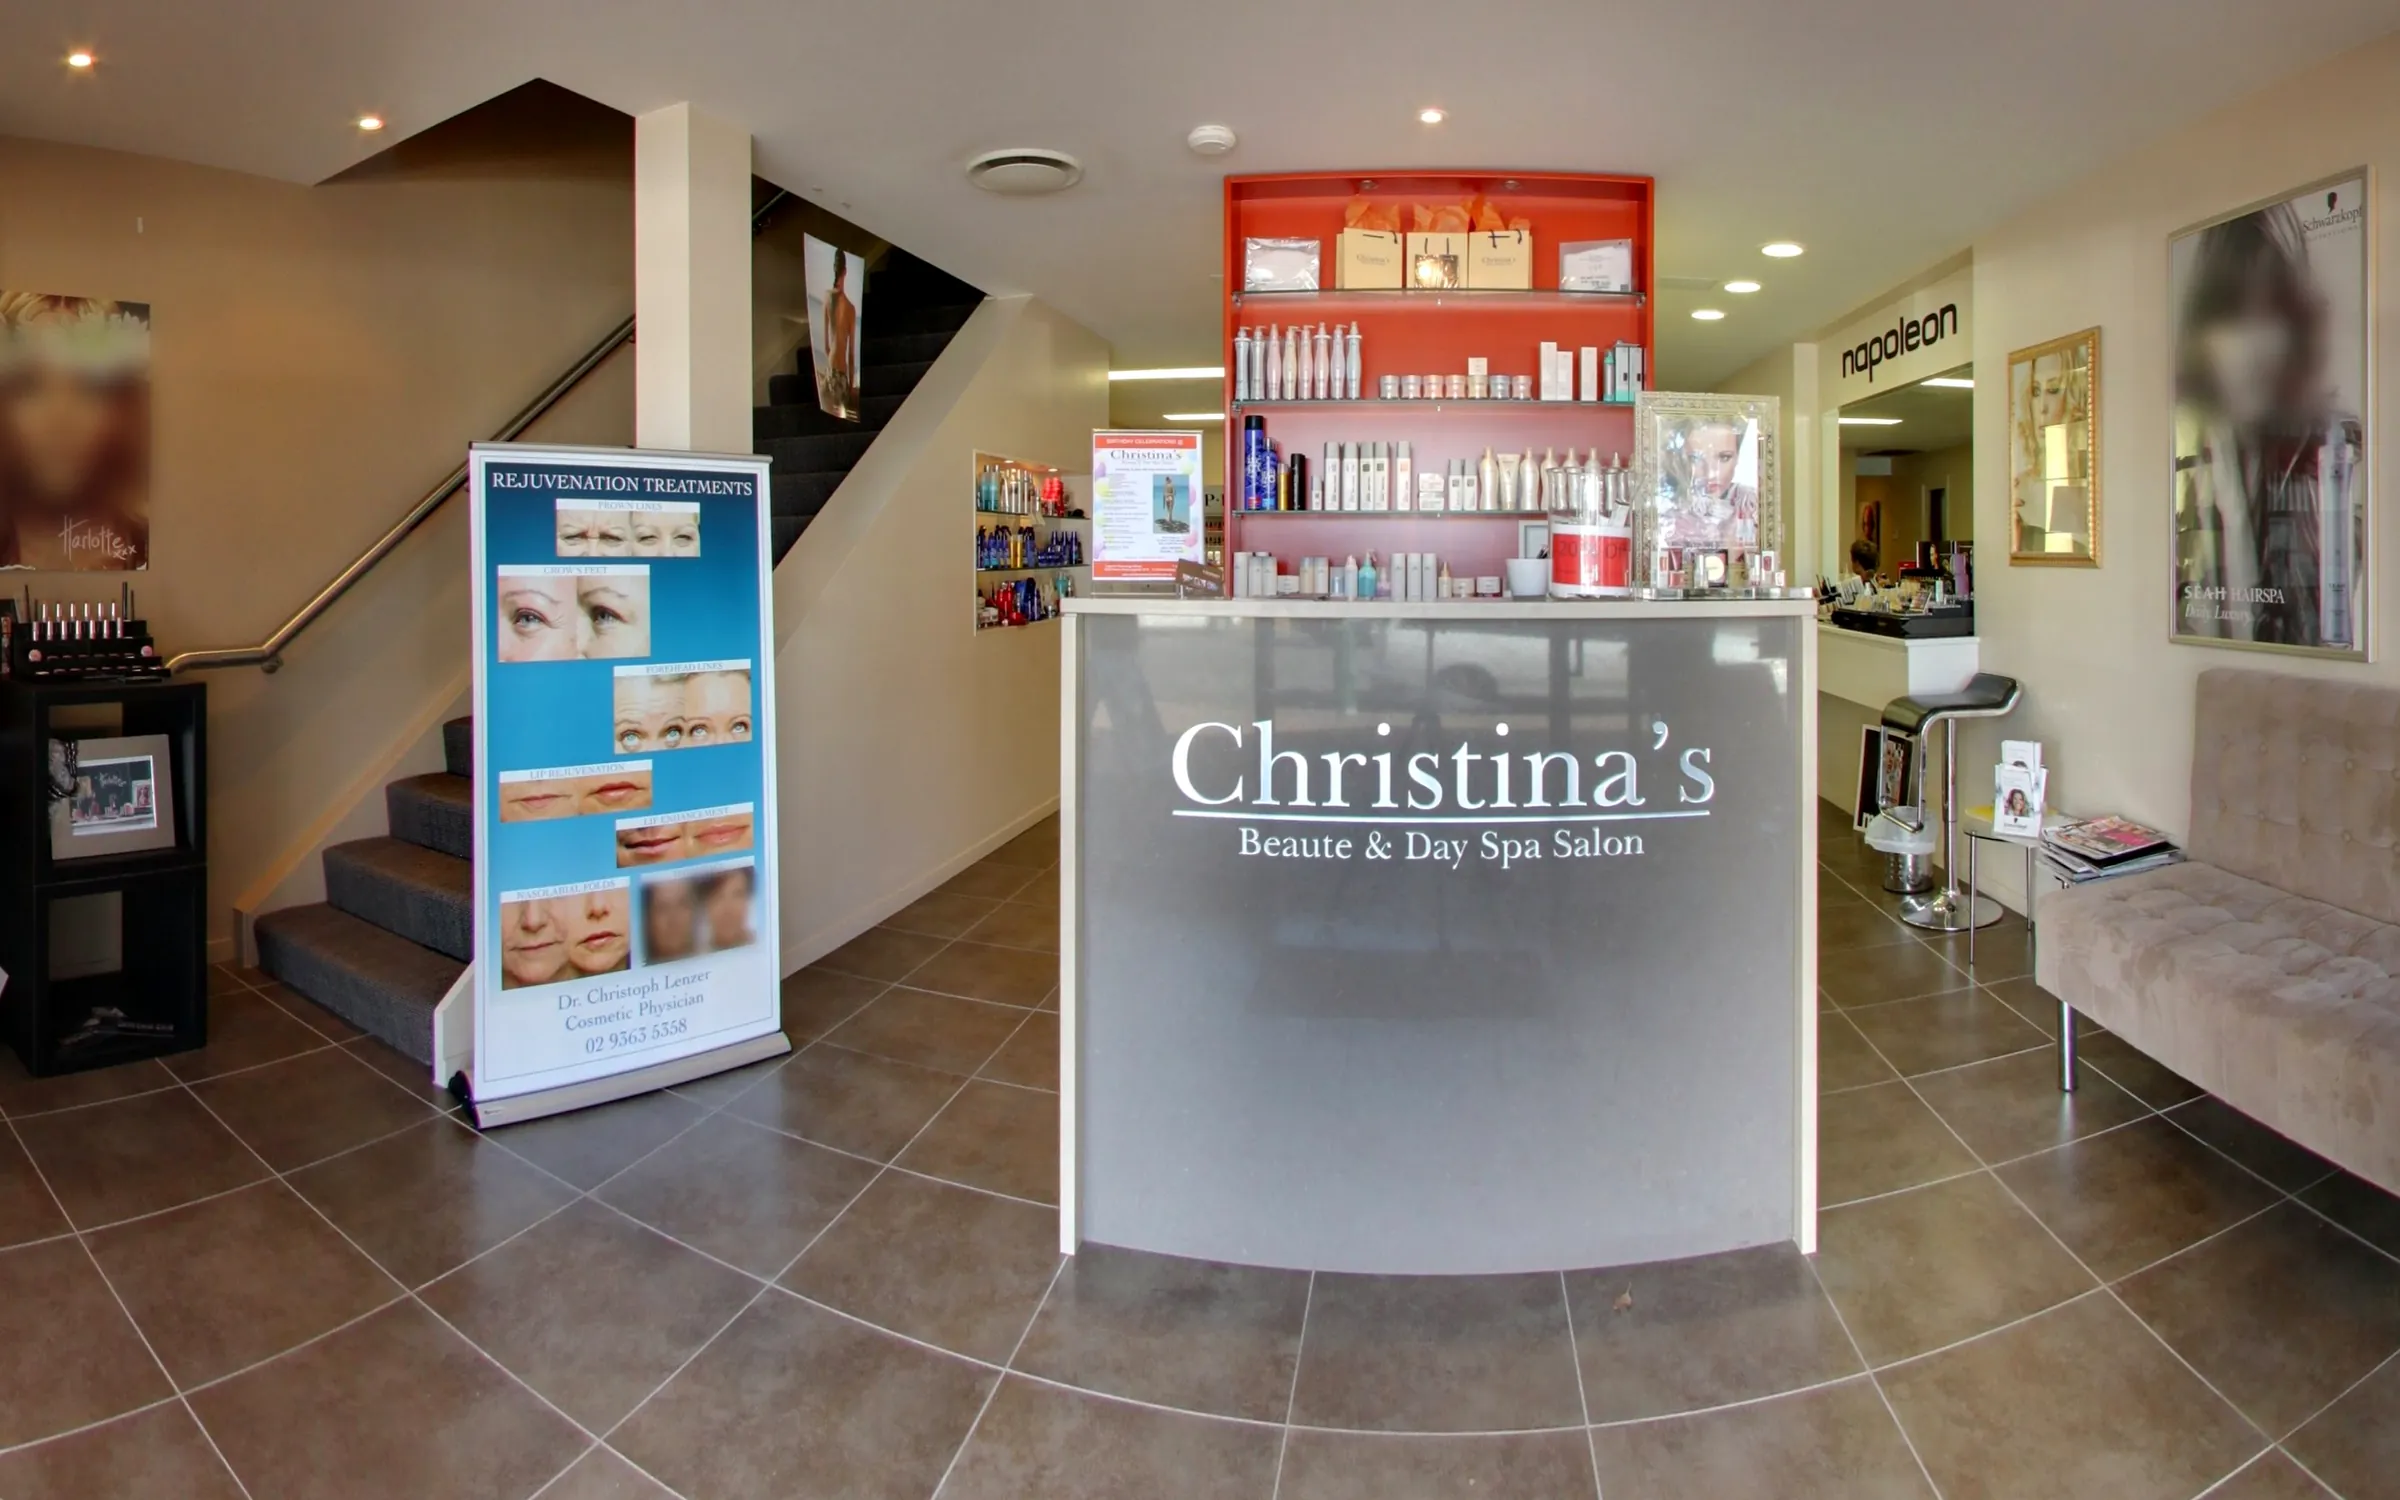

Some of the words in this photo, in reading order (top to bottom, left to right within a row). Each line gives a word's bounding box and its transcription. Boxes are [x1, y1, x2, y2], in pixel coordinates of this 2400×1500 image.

[1842, 303, 1957, 382] napoleon
[1110, 449, 1182, 460] Christina's
[492, 472, 640, 492] REJUVENATION
[643, 477, 753, 496] TREATMENTS
[635, 503, 663, 511] LINES
[58, 514, 124, 562] Harlotte
[2231, 587, 2285, 604] HAIRSPA
[646, 664, 696, 674] FOREHEAD
[697, 662, 723, 670] LINES
[530, 770, 547, 779] LIP
[548, 763, 625, 778] REJUVENATION
[1171, 720, 1715, 809] Christina's
[1239, 827, 1353, 860] Beaute
[1365, 831, 1392, 860] &
[1406, 831, 1468, 870] Day
[1480, 831, 1542, 869] Spa
[1553, 827, 1645, 859] Salon
[517, 884, 581, 900] NASOLABIAL
[583, 879, 616, 892] FOLDS
[557, 993, 582, 1011] Dr.
[587, 979, 660, 1007] Christoph
[664, 968, 712, 990] Lenzer
[565, 1006, 633, 1032] Cosmetic
[639, 993, 705, 1020] Physician
[585, 1036, 605, 1054] 02
[609, 1027, 647, 1051] 9363
[651, 1018, 688, 1041] 5358
